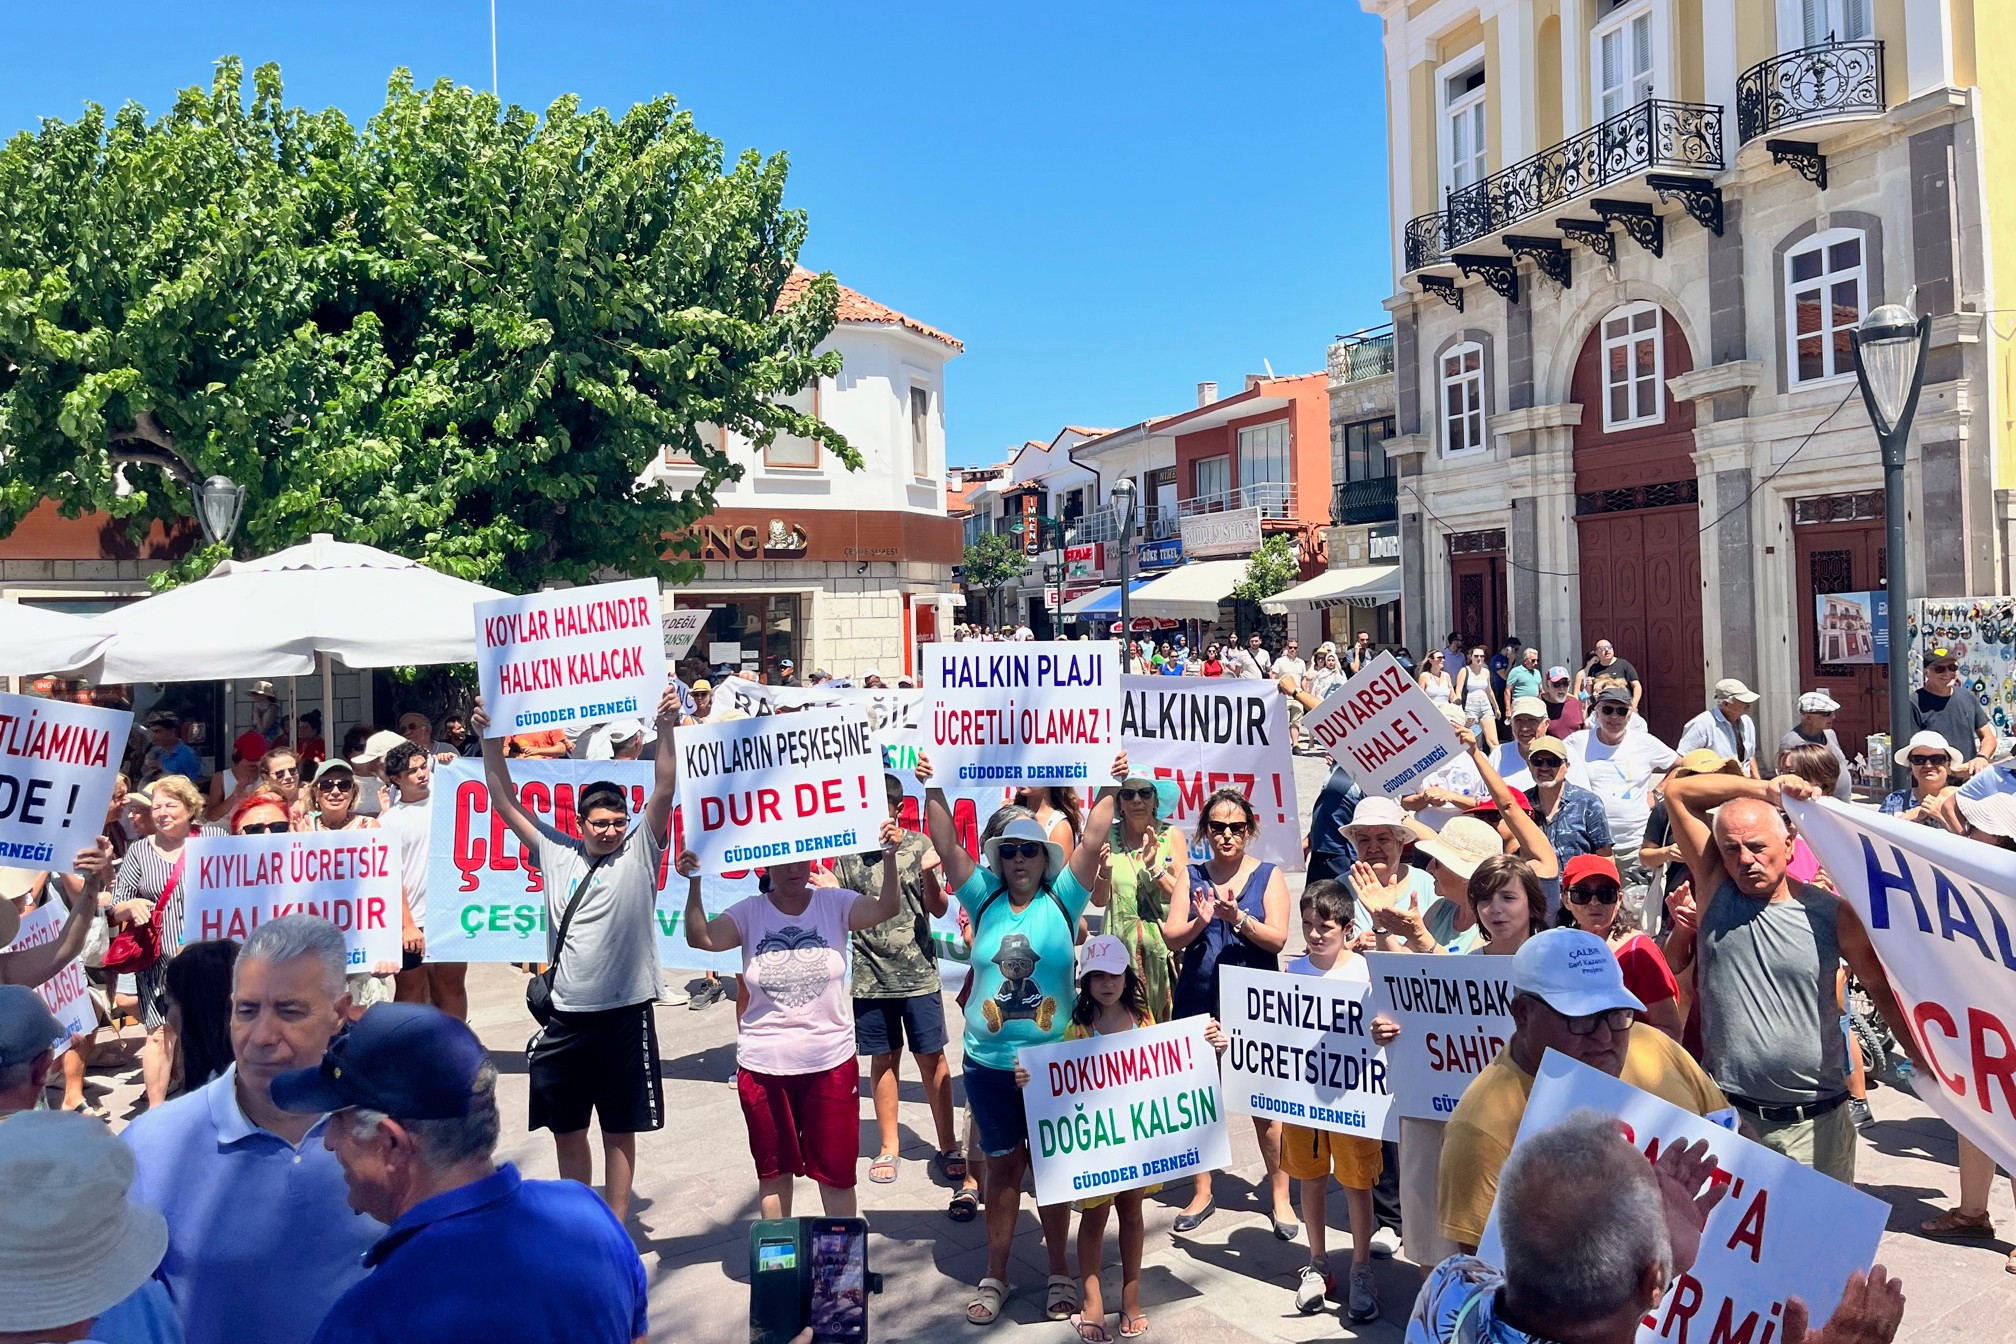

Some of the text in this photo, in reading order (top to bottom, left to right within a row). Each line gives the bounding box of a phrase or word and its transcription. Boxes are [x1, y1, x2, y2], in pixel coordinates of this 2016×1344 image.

[1160, 547, 1179, 560] TEKEL
[1185, 519, 1255, 546] BODRUM SHOES
[1370, 531, 1399, 559] İMR
[485, 596, 651, 648] KOYLAR HALKINDIR
[664, 633, 694, 646] ZANSIN
[668, 615, 697, 629] DEĞİL
[500, 646, 645, 695] HALKIN KALACAK
[942, 654, 1102, 688] HALKIN PLAJI
[515, 696, 638, 727] GÜDODER DERNEĞİ
[934, 700, 1015, 746] ÜCRETLİ
[1121, 690, 1269, 746] ALKINDIR
[1314, 665, 1412, 748] DUYARSIZ
[0, 708, 110, 768] TLİAMINA
[686, 716, 872, 778] KOYLARIN PEŞKEŞİNE
[1347, 718, 1418, 773] İHALE
[959, 761, 1088, 780] GÜDODER DERNEĞİ
[1383, 743, 1449, 793] GÜDODER DERNEĞİ
[701, 788, 782, 832] DUR
[794, 779, 845, 818] DE
[200, 837, 389, 890] KIYILAR ÜCRETSİZ
[724, 828, 857, 864] GÜDODER DERNEĞİ
[1857, 832, 2016, 973] HAL
[1247, 984, 1364, 1037] DENİZLER
[1383, 968, 1514, 1017] TURİZM BAK
[1049, 1038, 1182, 1097] DOKUNMAYIN
[1230, 1028, 1387, 1096] ÜCRETSİZDİR
[1038, 1086, 1217, 1158] DOĞAL KALSIN
[1250, 1093, 1366, 1129] GÜDODER DERNEĞİ
[1073, 1147, 1200, 1190] GÜDODER DERNEĞİ
